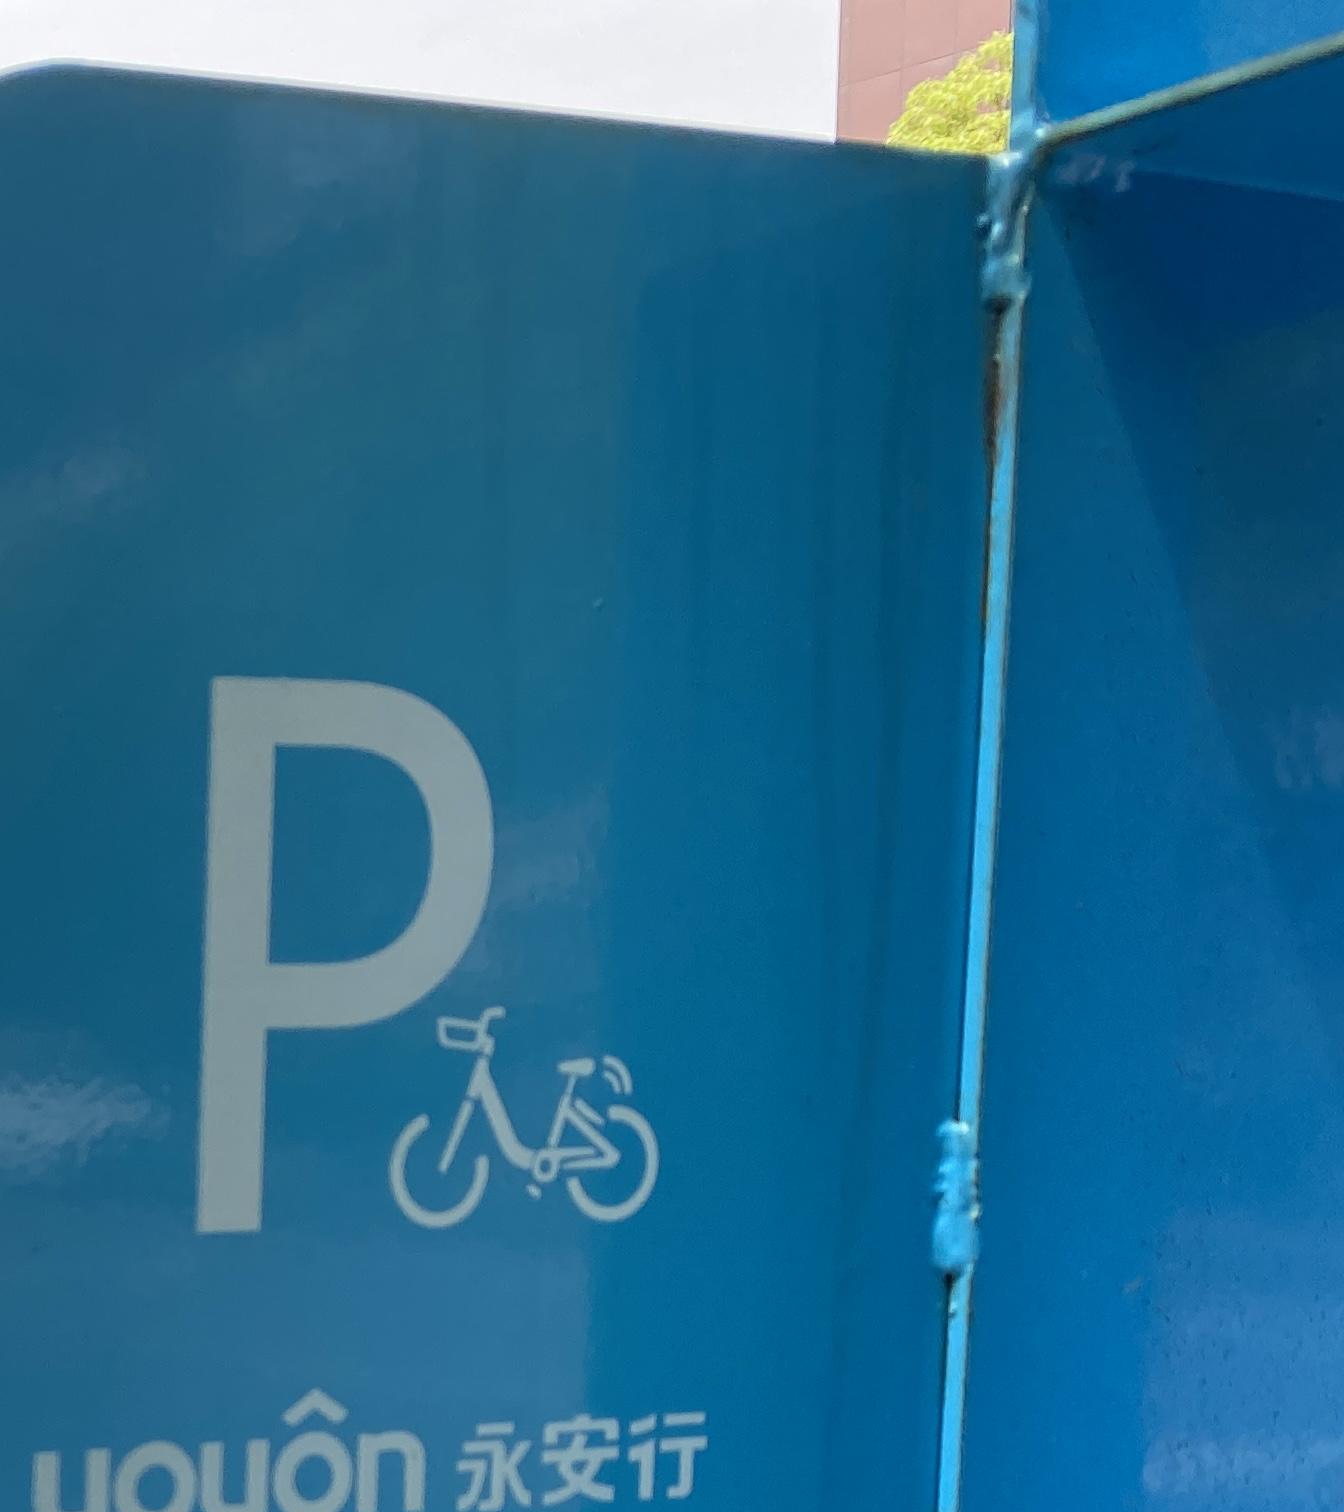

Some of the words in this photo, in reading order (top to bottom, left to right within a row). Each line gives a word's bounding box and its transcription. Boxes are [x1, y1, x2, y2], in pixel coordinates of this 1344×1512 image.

[196, 676, 494, 1234] P
[456, 1411, 709, 1512] 永安行
